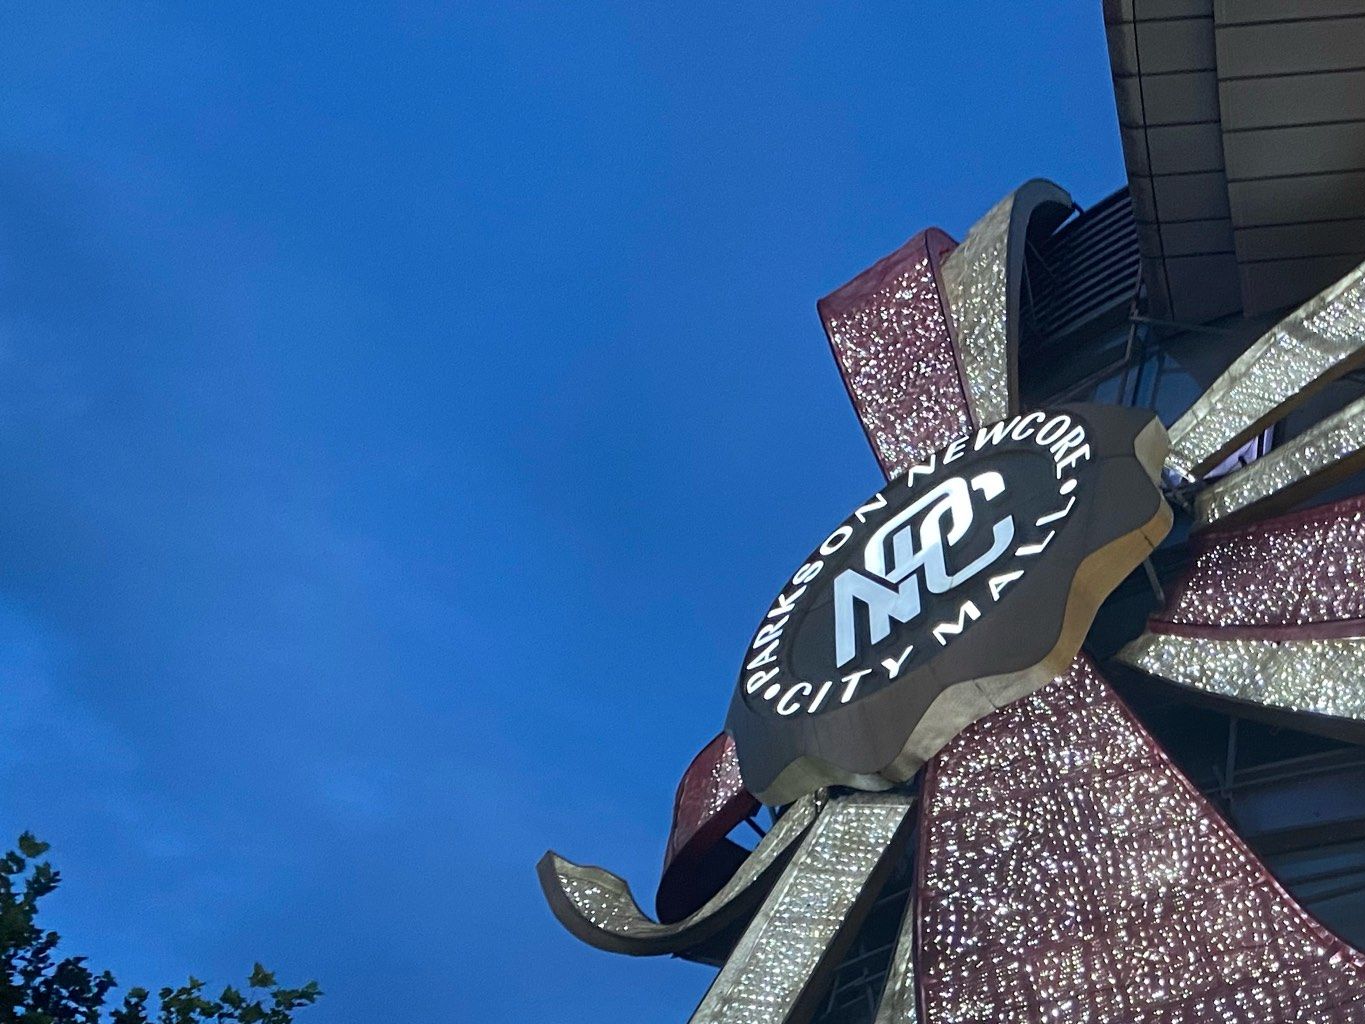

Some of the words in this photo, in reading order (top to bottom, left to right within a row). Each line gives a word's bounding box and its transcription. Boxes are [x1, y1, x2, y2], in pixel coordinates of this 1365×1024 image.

[746, 492, 889, 695] PARKSON
[907, 410, 1091, 480] NEWCORE
[776, 645, 914, 716] CITY
[932, 495, 1077, 646] MALL
